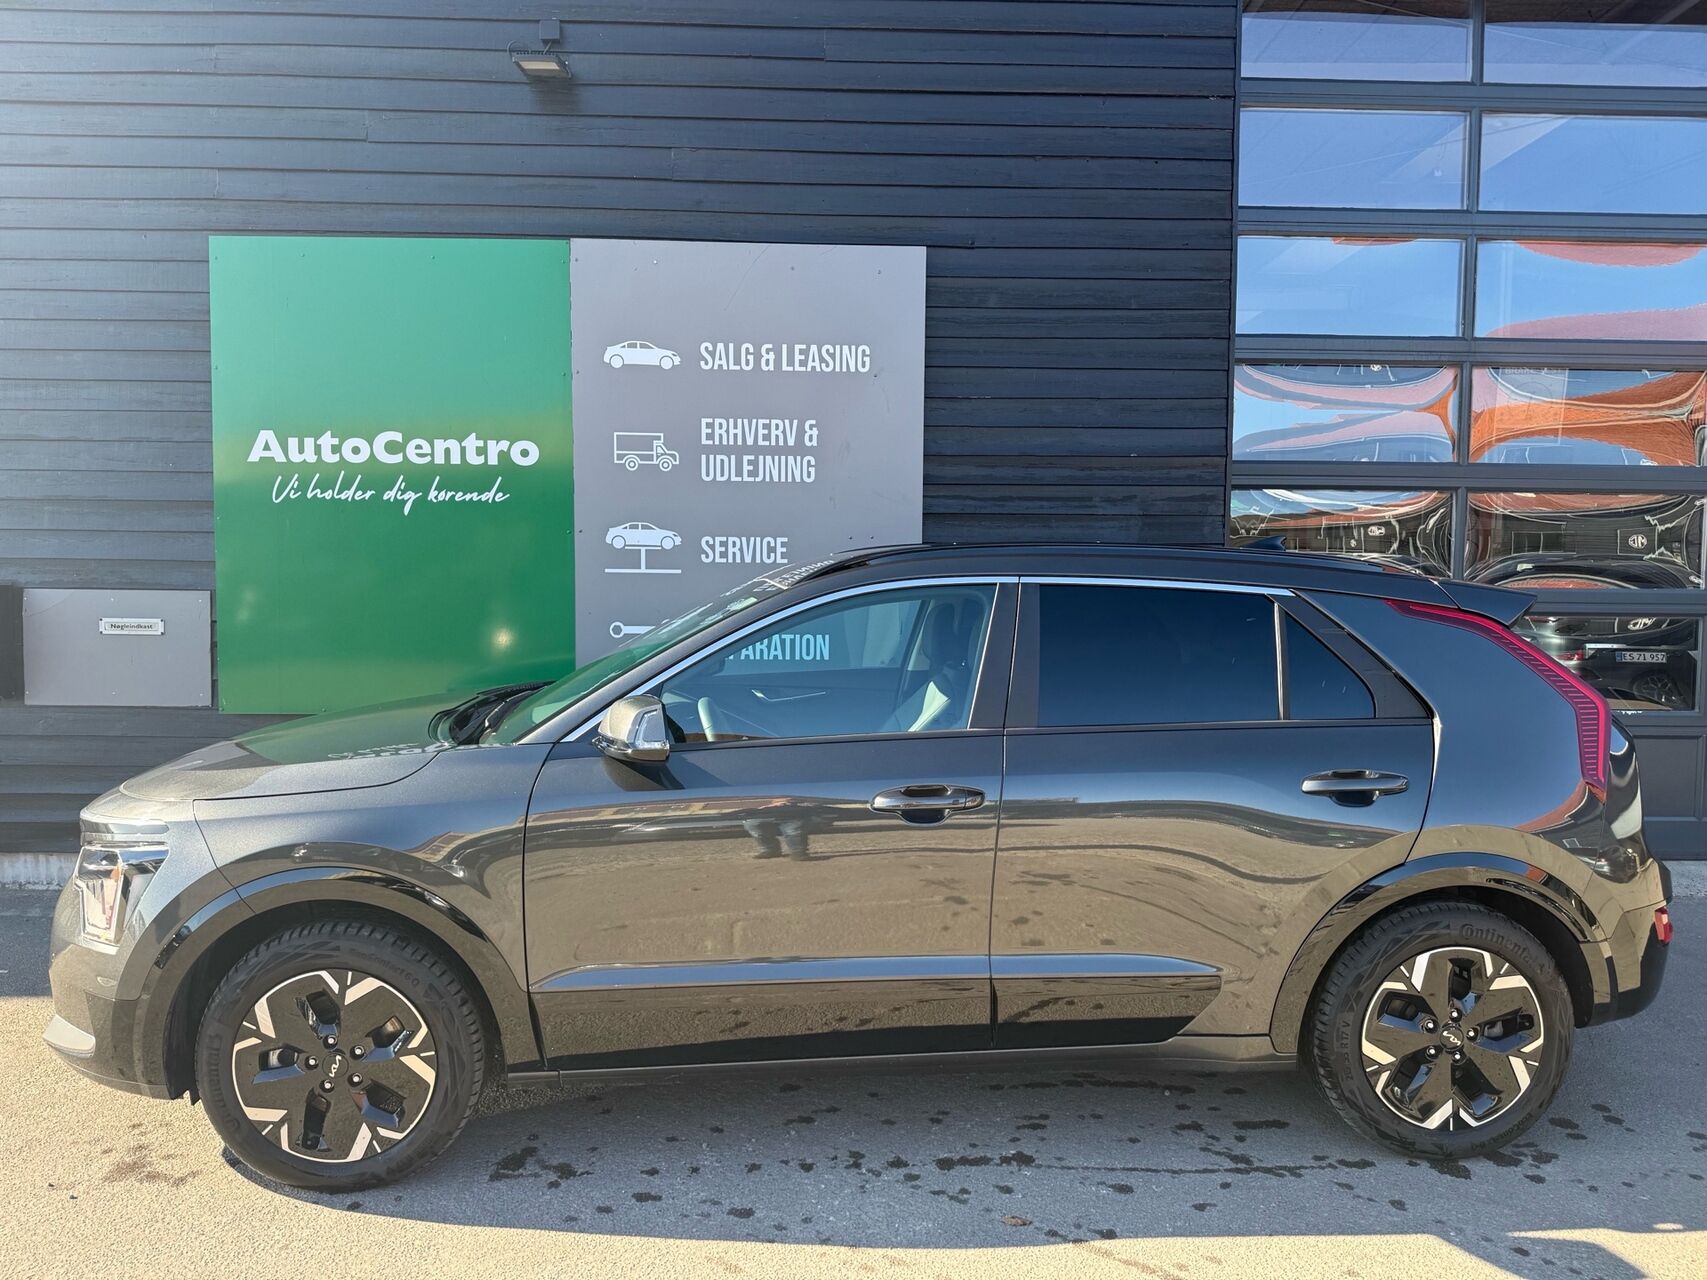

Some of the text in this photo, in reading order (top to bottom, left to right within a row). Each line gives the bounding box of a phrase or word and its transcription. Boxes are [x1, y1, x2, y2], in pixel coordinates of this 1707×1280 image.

[700, 342, 871, 373] SALG & LEASING
[701, 418, 819, 447] ERHVERV &
[247, 430, 540, 466] AutoCentro
[701, 454, 816, 483] UDLEJNING
[272, 470, 510, 516] Vi holder dig kørende
[700, 536, 788, 564] SERVICE
[1622, 652, 1666, 662] ES 71 957
